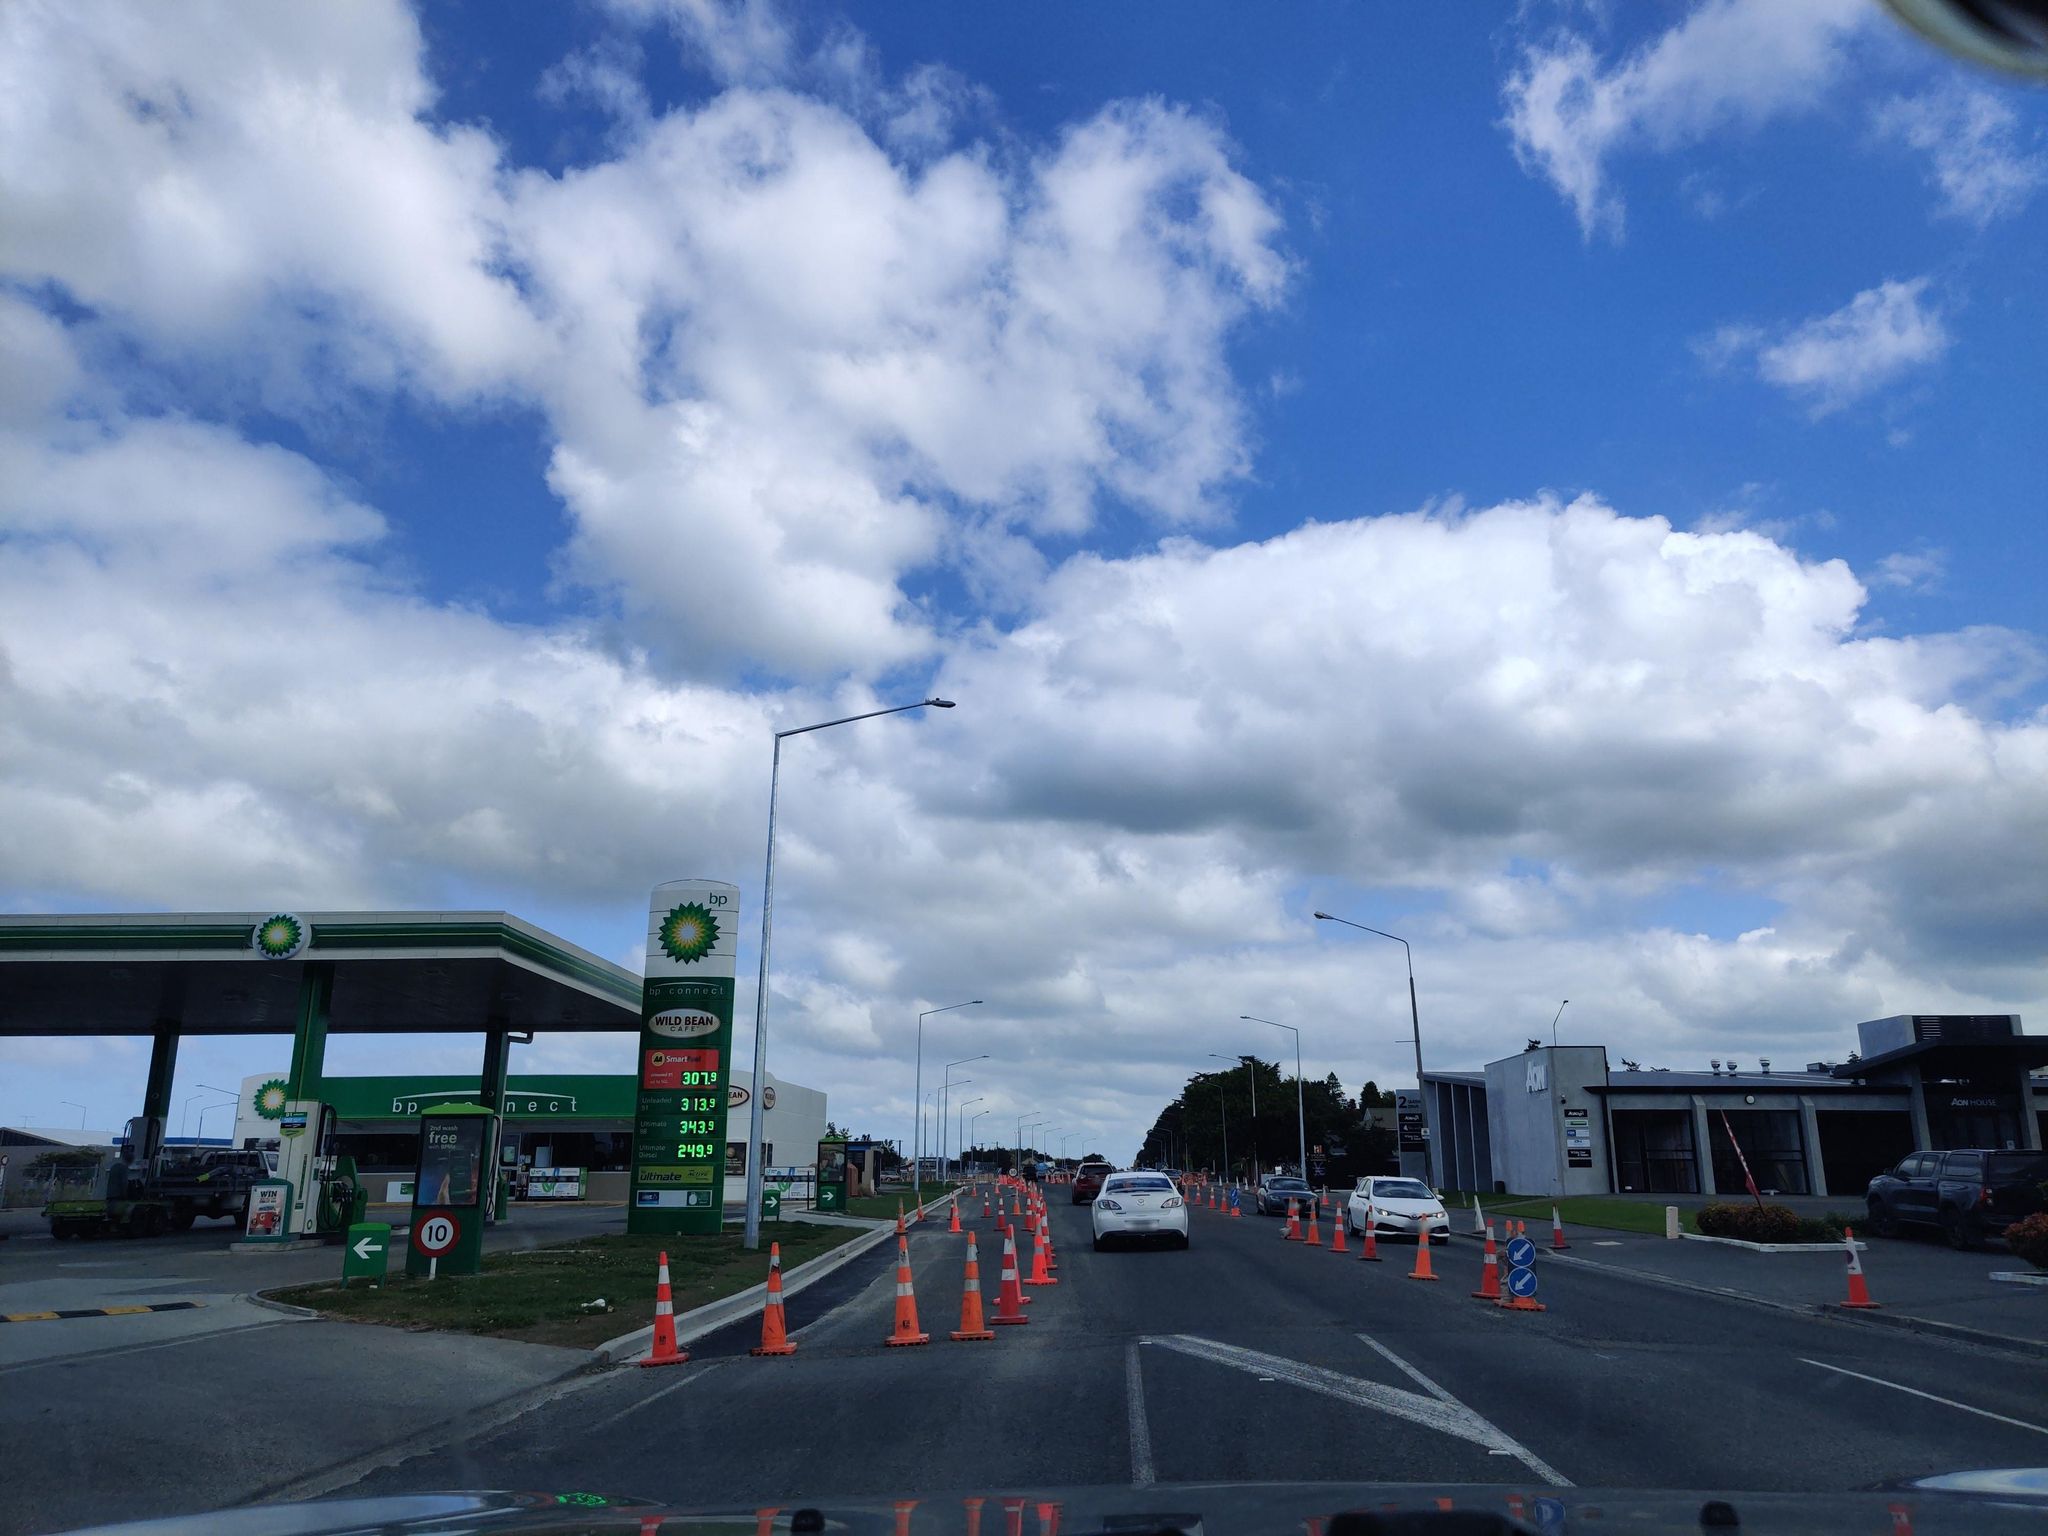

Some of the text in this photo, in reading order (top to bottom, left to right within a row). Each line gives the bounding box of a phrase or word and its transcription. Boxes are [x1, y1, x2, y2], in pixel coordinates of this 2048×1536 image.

[709, 892, 728, 907] bp
[649, 986, 724, 996] bp connect
[655, 1016, 714, 1026] WILD BEAN
[682, 1071, 717, 1086] 307.9
[392, 1098, 418, 1115] bp
[641, 1096, 716, 1112] Unleaded 313.9
[1398, 1096, 1407, 1108] 2
[1970, 1098, 1997, 1106] HOUSE
[640, 1120, 715, 1134] Ultimate 343.9
[428, 1131, 458, 1144] free
[638, 1151, 658, 1159] Diesel
[639, 1144, 713, 1158] Ultimate 249.9
[640, 1171, 682, 1181] ultimate
[260, 1190, 278, 1198] WIN
[428, 1225, 447, 1242] 10
